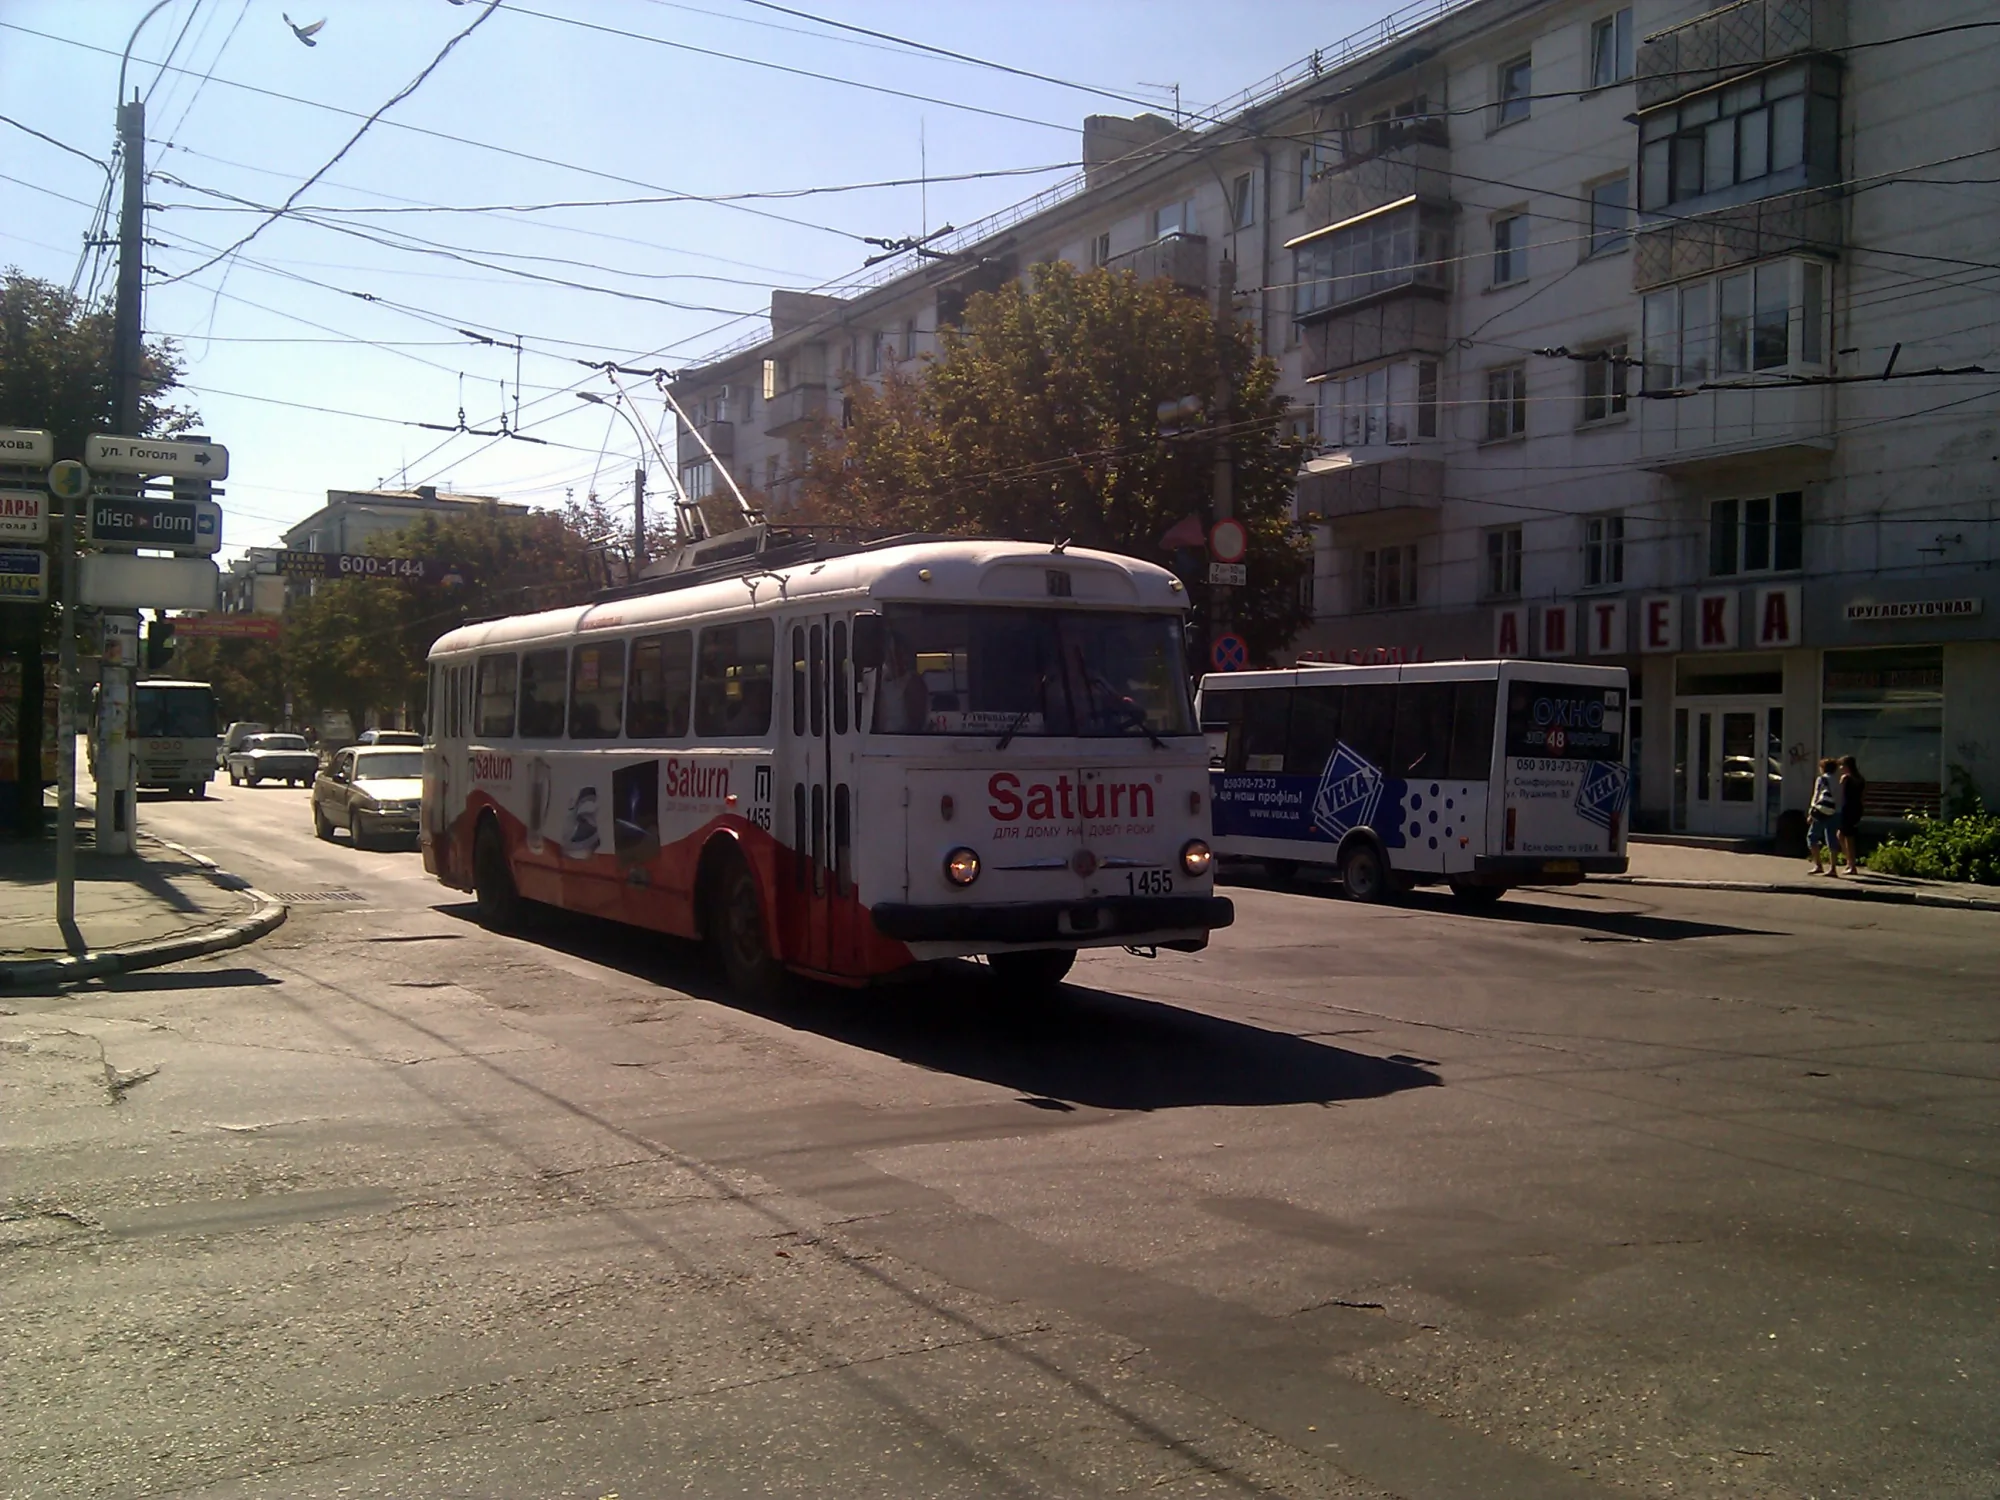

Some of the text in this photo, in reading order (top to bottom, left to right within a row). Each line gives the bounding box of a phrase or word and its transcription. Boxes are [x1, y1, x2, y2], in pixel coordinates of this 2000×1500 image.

[101, 446, 178, 461] ул. Гоголя
[153, 512, 192, 531] dom
[339, 556, 425, 577] 600-144
[1848, 600, 1973, 618] КРУГЛОСУТОЧНАЯ
[1500, 591, 1790, 655] АПТЕКА
[1533, 697, 1605, 728] ОКНО
[1547, 731, 1565, 747] 48
[475, 752, 512, 781] Saturn
[666, 757, 729, 798] Saturn
[1517, 759, 1586, 773] 050 393-73-73
[988, 772, 1154, 821] Saturn
[1234, 791, 1255, 801] наш
[1322, 769, 1369, 815] VEKA
[1585, 771, 1619, 806] VEKA
[746, 807, 771, 831] 1455
[993, 827, 1020, 840] ДЛЯ
[1025, 825, 1061, 839] ДОМУ
[1067, 826, 1083, 837] НА
[1126, 870, 1173, 895] 1455
